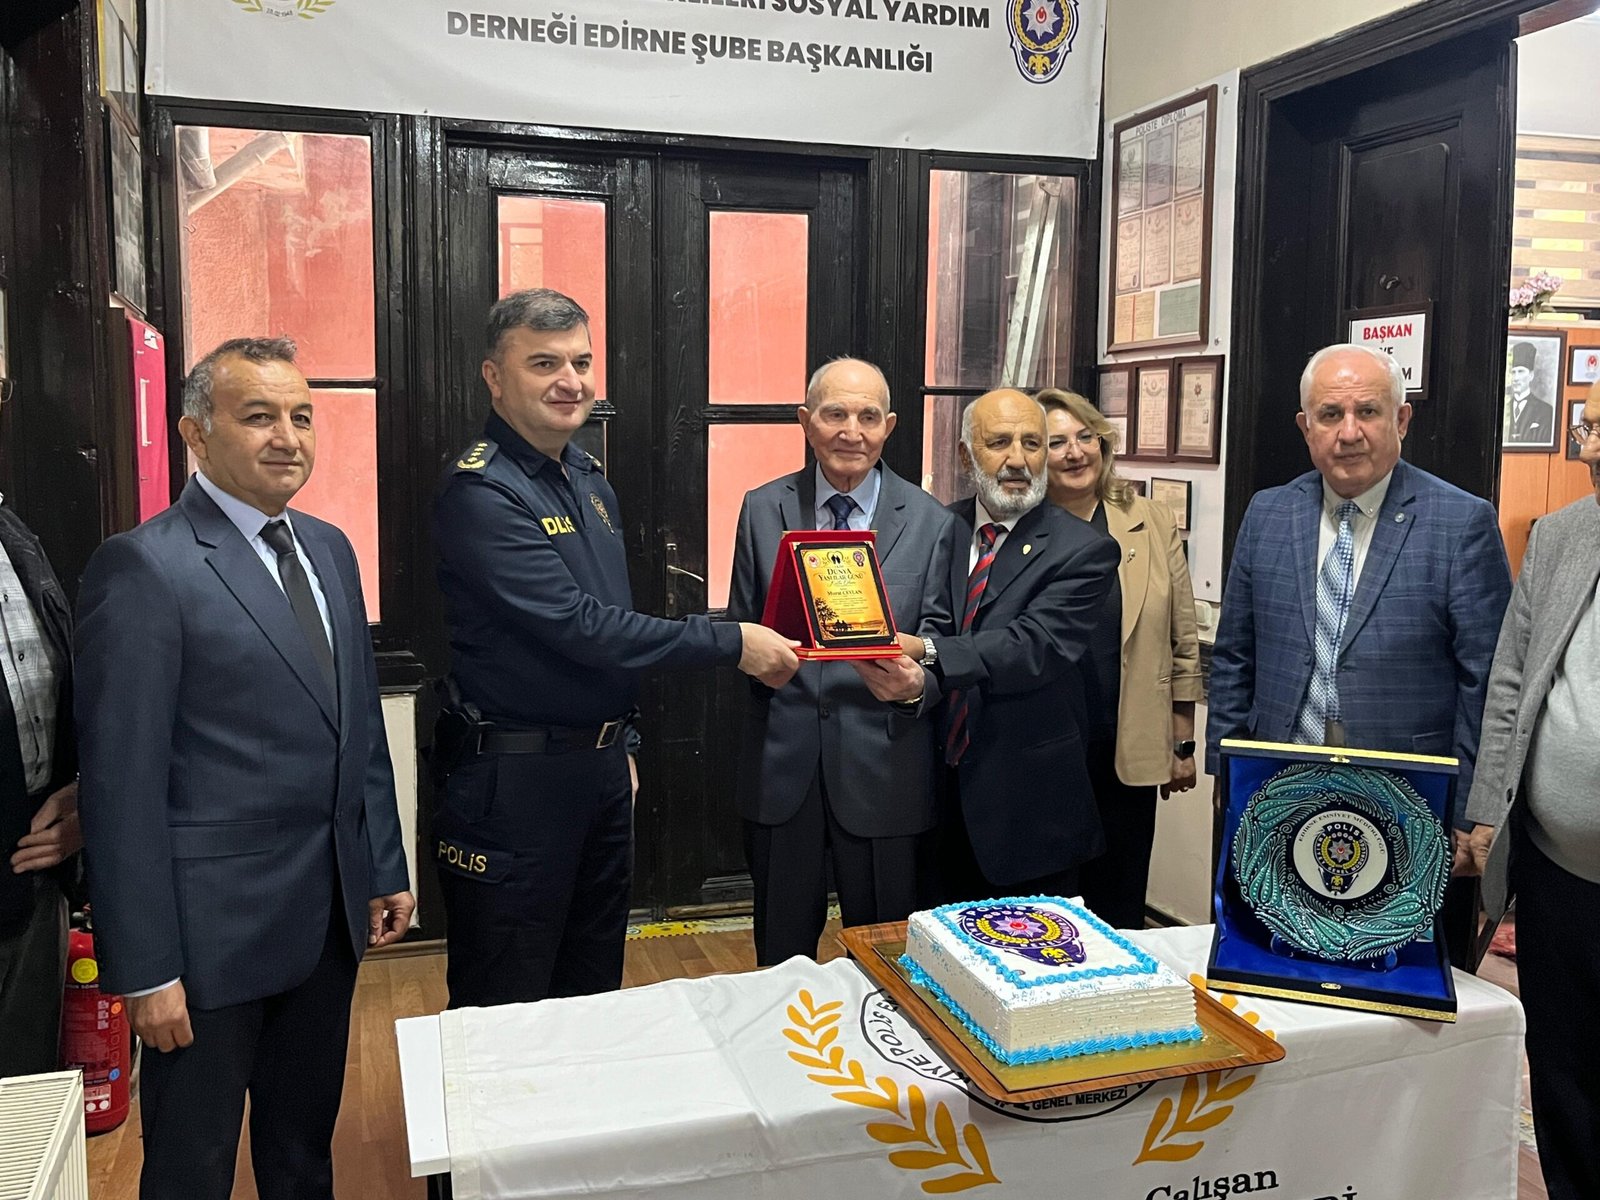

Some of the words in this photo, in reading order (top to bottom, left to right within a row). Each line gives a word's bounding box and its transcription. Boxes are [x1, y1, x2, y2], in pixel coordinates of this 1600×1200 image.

[887, 0, 990, 29] YARDIM
[447, 10, 577, 46] DERNEĞİ
[583, 20, 686, 54] EDİRNE
[691, 33, 761, 65] ŞUBE
[767, 41, 933, 73] BAŞKANLIĞI
[1363, 323, 1412, 343] BAŞKAN
[438, 840, 487, 873] POLİS
[1032, 1099, 1073, 1111] GENEL
[1075, 1086, 1128, 1105] MERKEZİ
